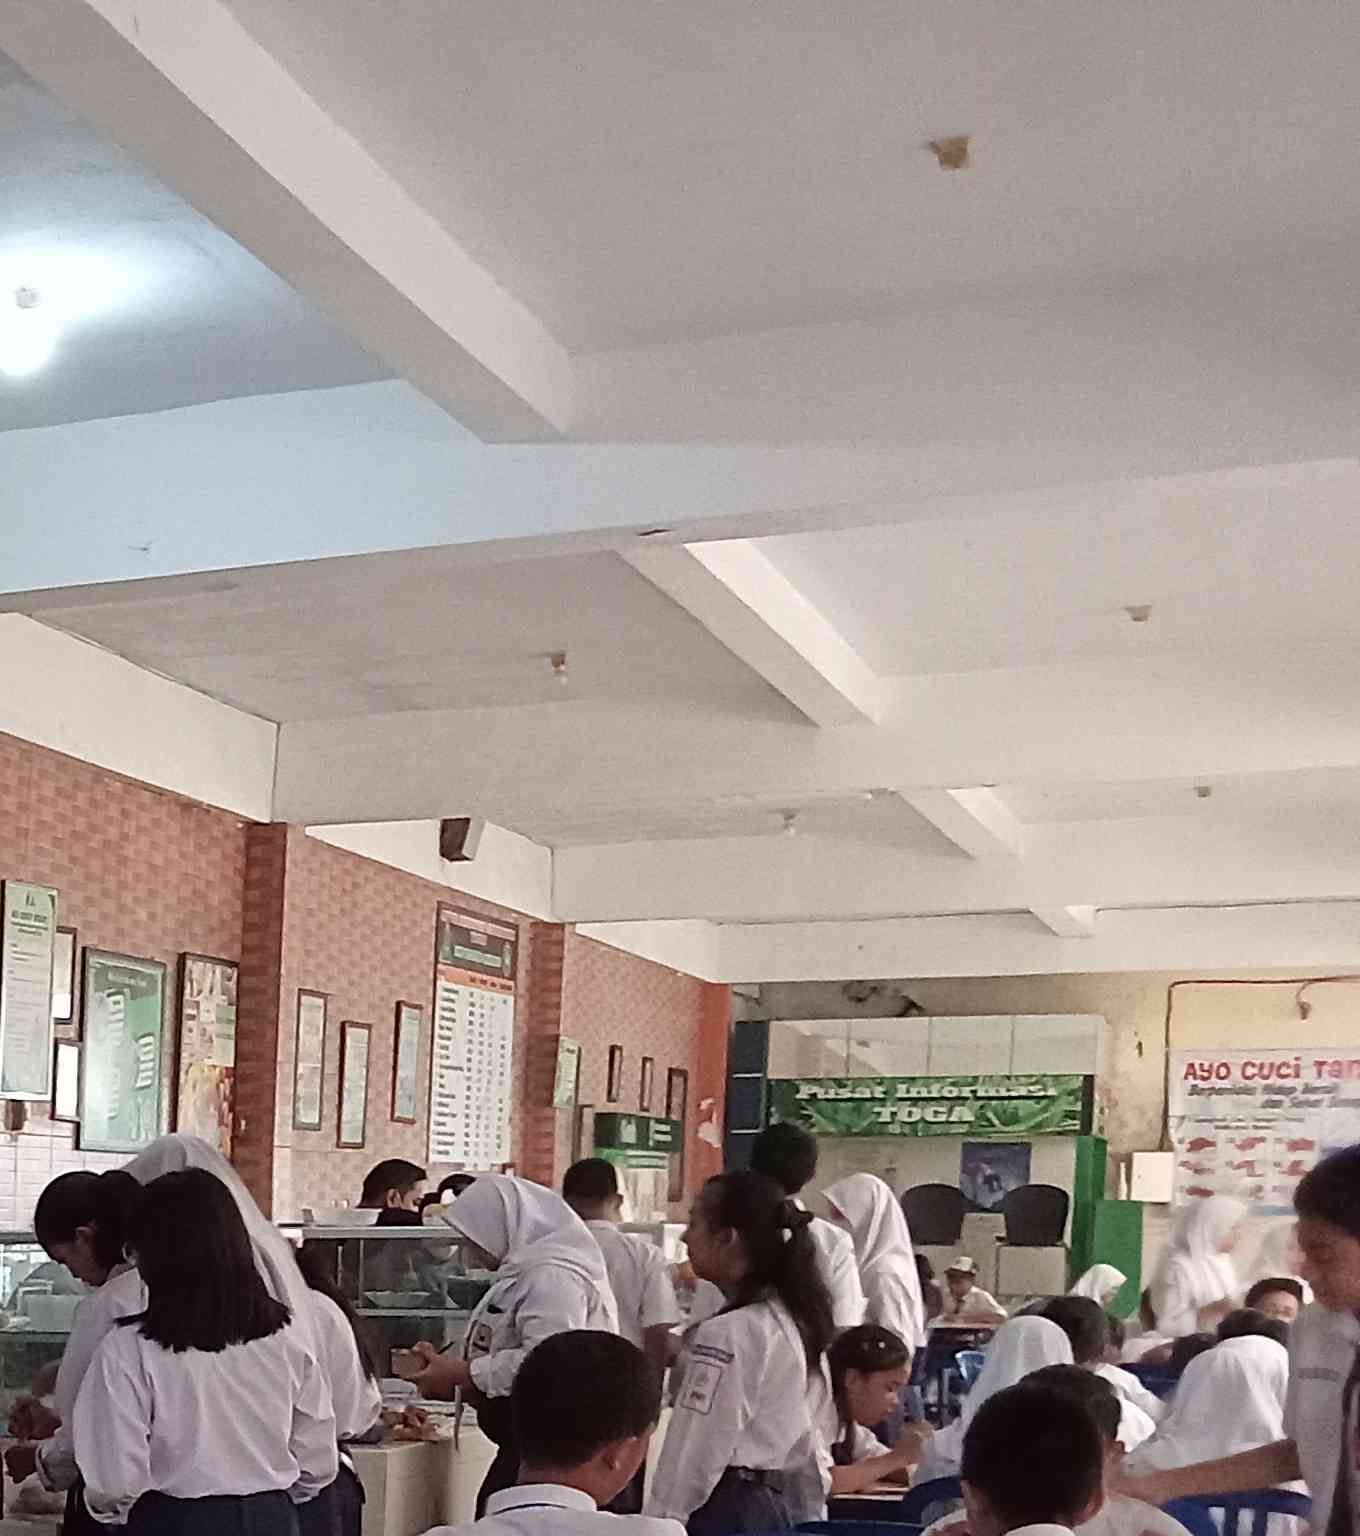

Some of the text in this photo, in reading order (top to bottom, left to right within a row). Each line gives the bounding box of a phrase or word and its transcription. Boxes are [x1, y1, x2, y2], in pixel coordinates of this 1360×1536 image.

[795, 1083, 1057, 1099] Pusat Informasi
[872, 1105, 975, 1124] TOGA
